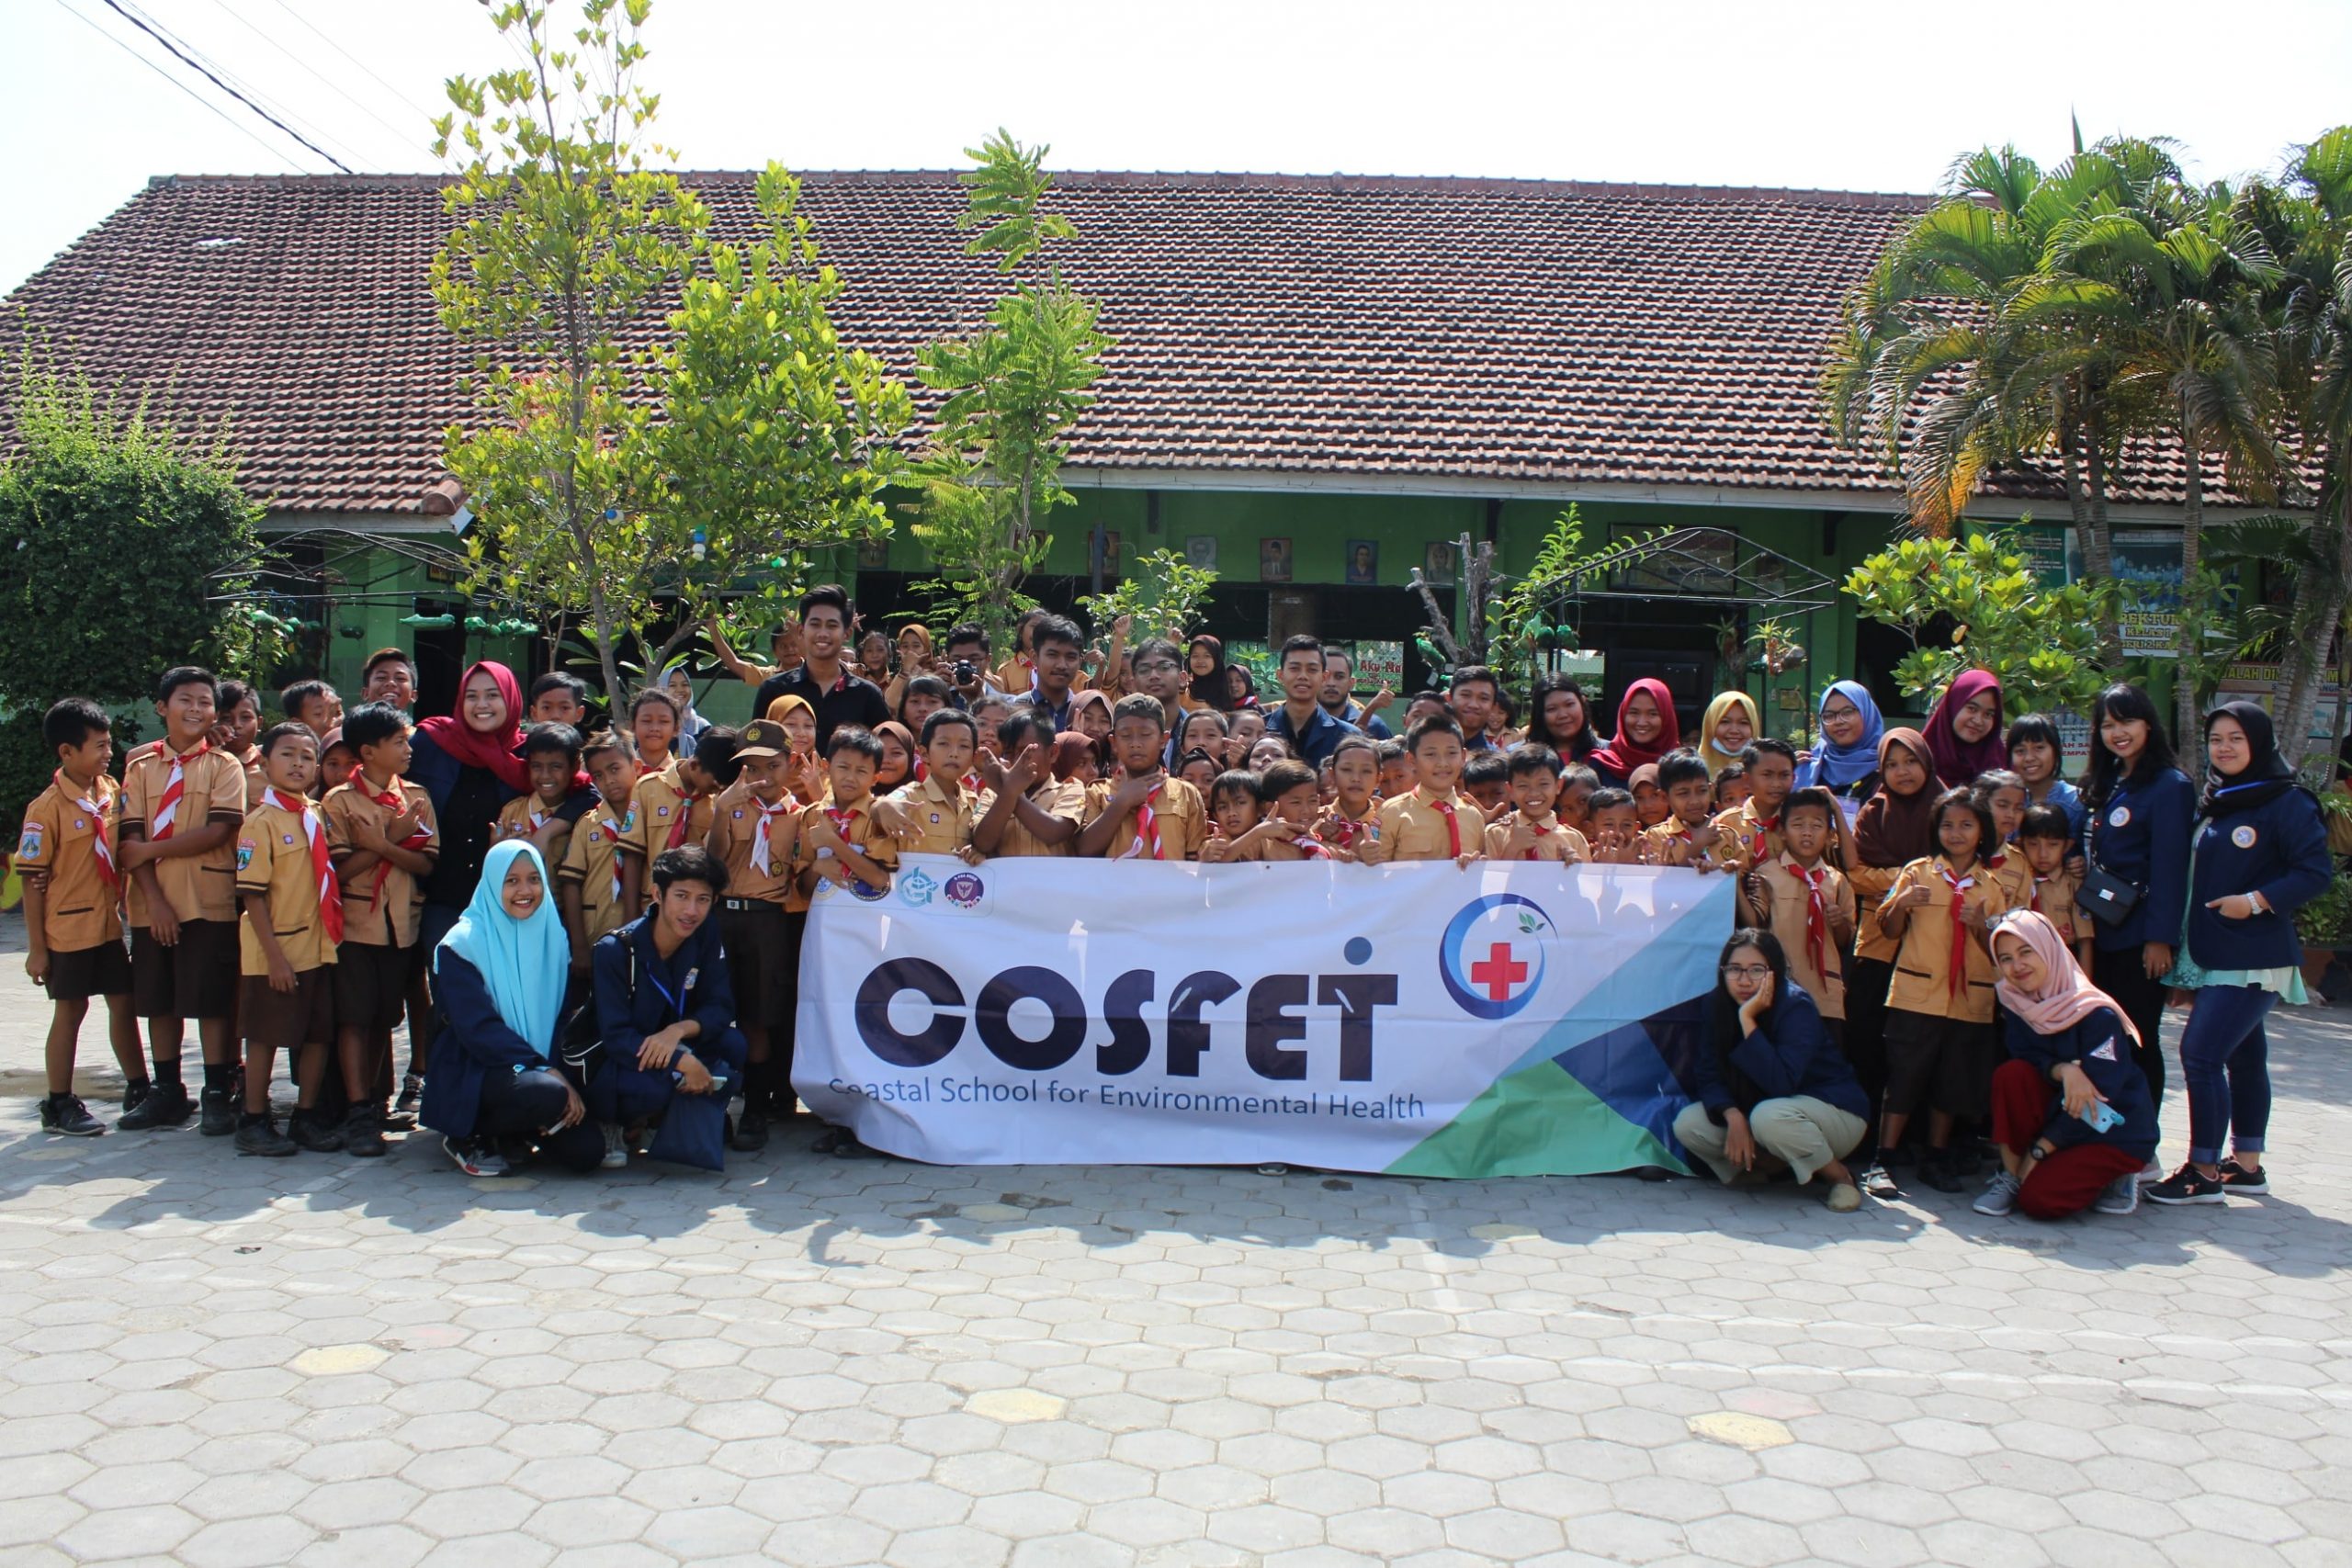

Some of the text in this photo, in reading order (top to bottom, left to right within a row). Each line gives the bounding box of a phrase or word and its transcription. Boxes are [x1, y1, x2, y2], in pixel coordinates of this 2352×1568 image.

[941, 1077, 1037, 1102] School
[1047, 1080, 1090, 1103] for
[1101, 1085, 1317, 1114] Environmental
[1329, 1093, 1425, 1119] Health
